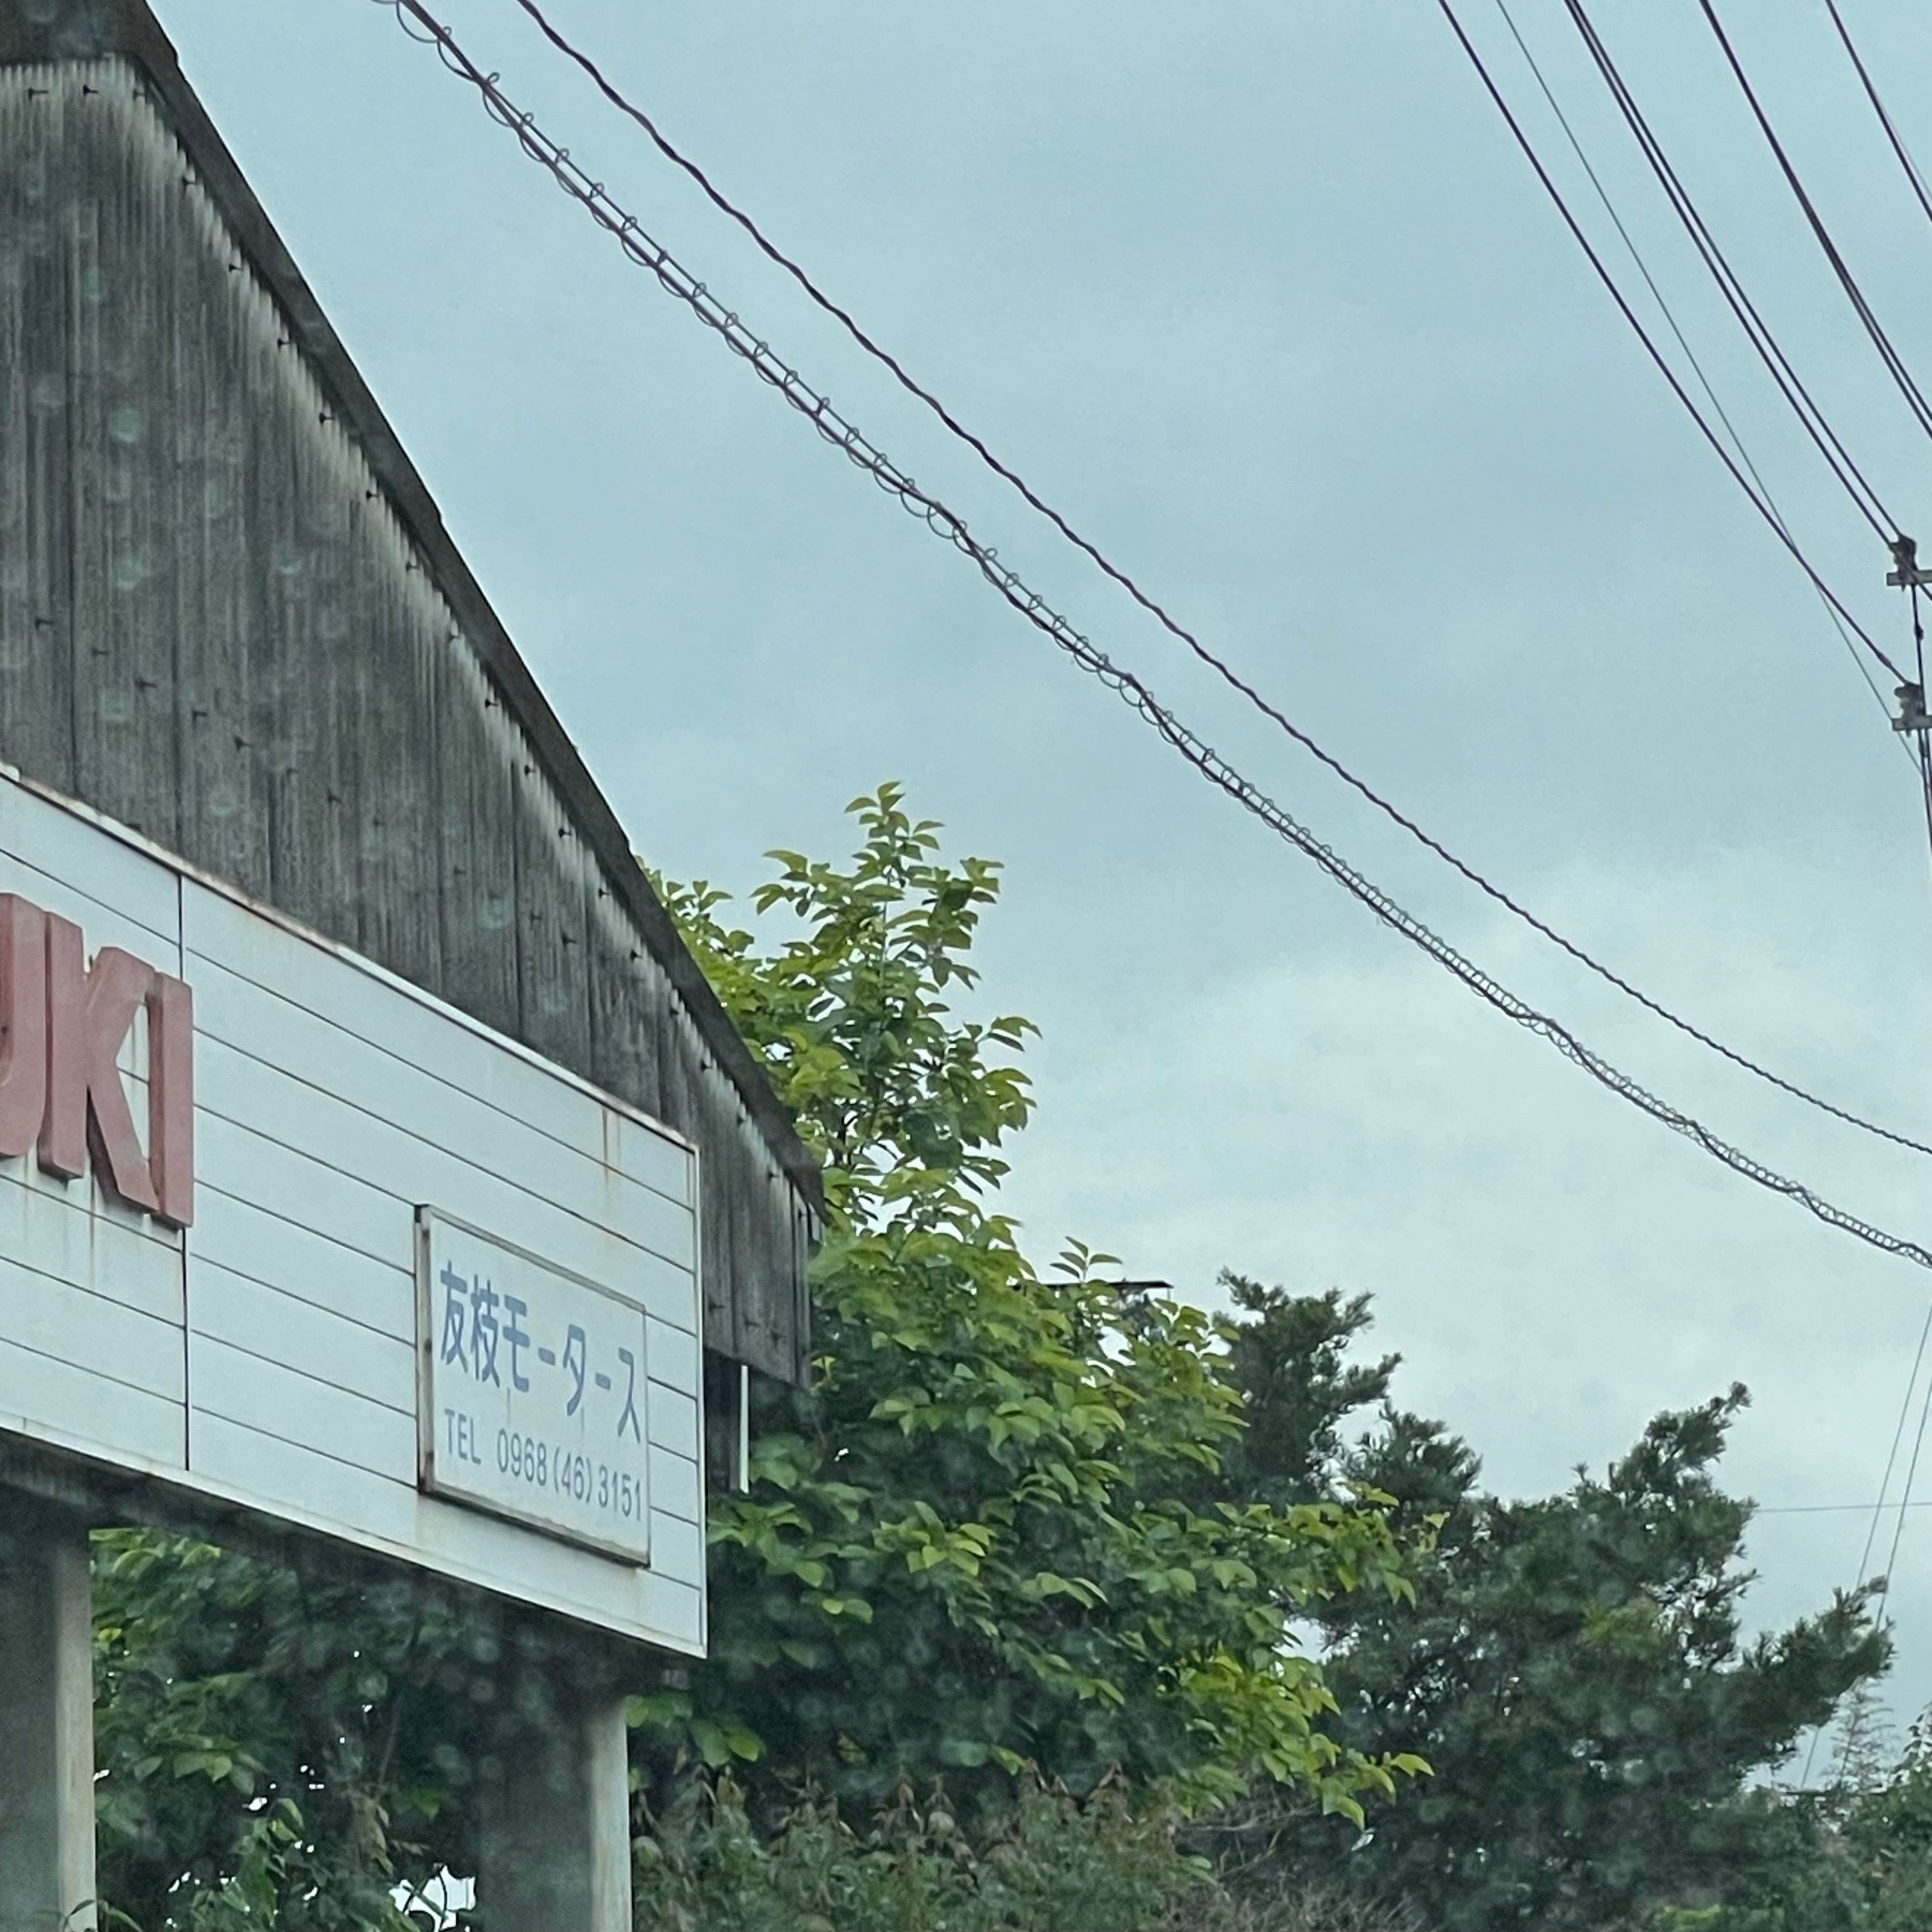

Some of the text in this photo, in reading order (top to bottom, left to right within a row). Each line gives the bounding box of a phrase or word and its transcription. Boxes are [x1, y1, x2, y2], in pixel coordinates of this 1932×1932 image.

[440, 1260, 640, 1444] 友枝モータース
[443, 1407, 641, 1521] TEL 0968(46)3151
